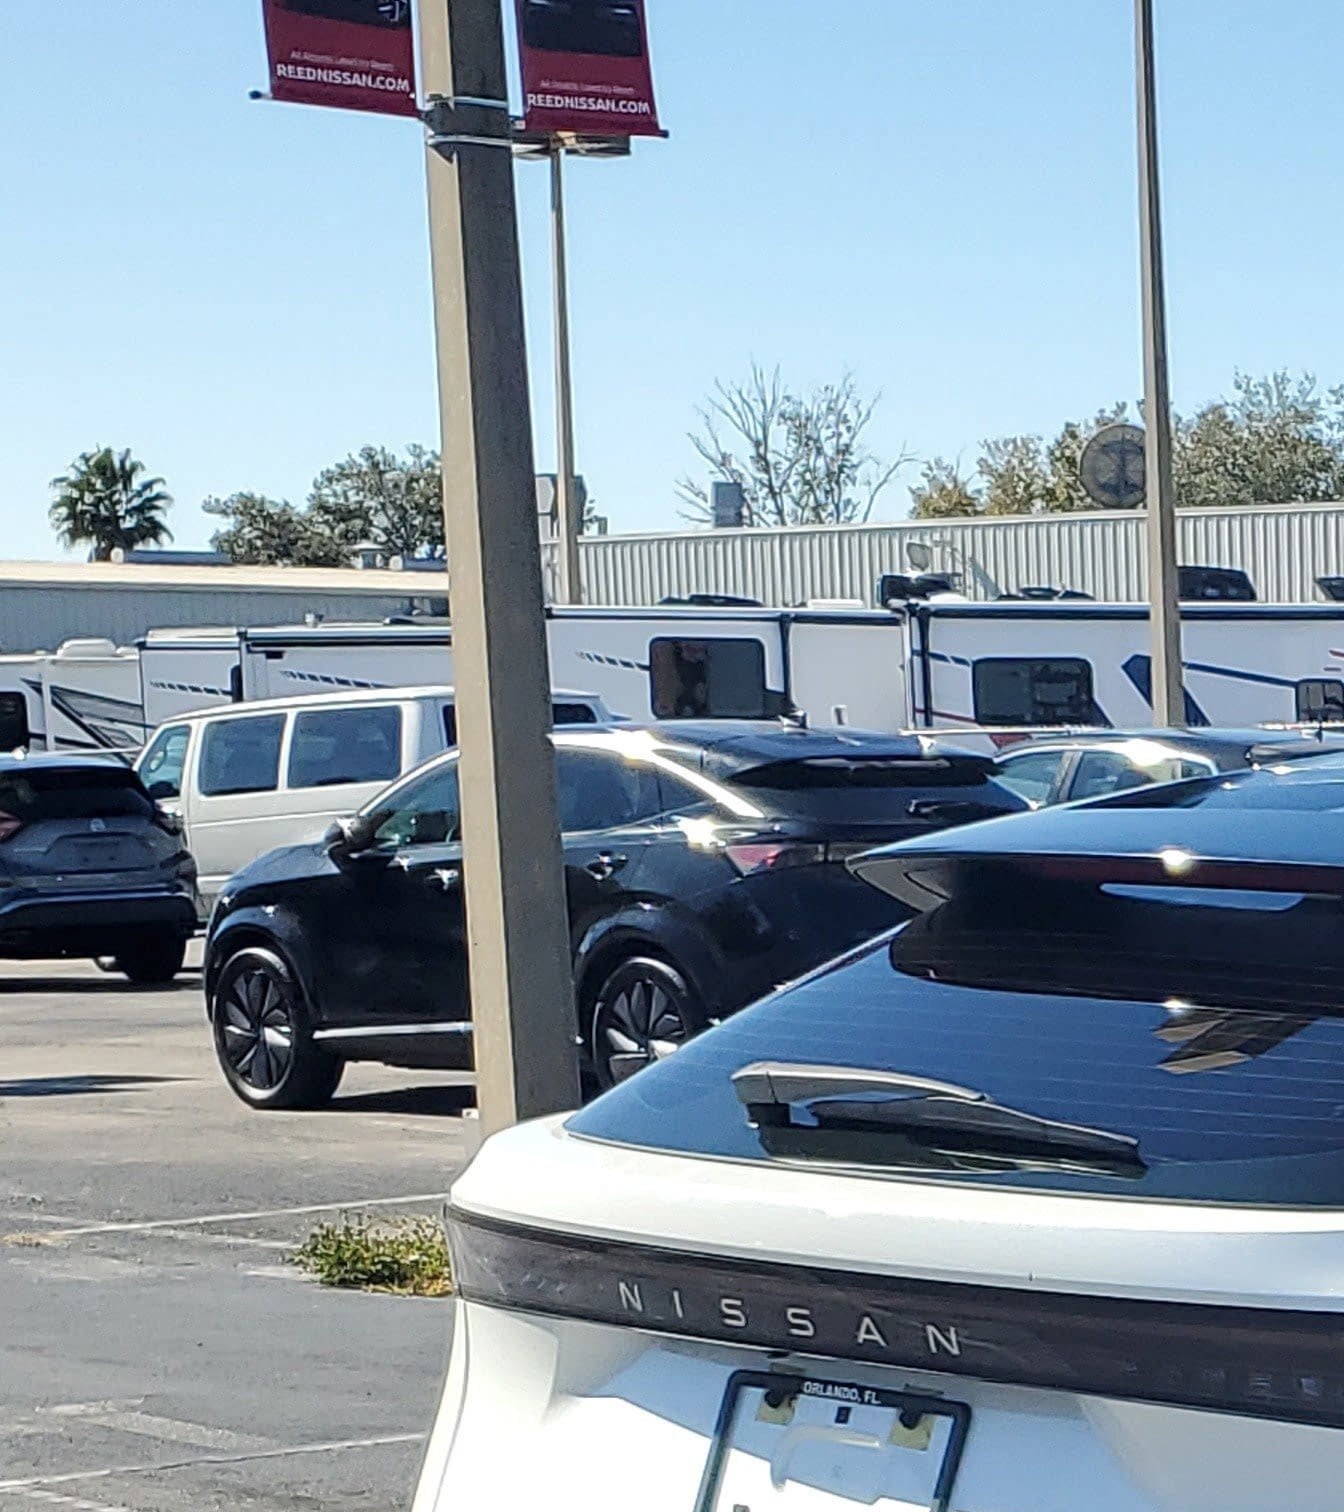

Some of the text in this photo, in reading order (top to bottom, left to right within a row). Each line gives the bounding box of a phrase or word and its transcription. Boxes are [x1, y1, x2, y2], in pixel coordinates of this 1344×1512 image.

[276, 63, 410, 92] REEDNISSAN.COM
[526, 93, 650, 114] REEDNISSAN.COM
[618, 1281, 961, 1356] NISSAN
[803, 1381, 881, 1404] ORLANDO, FL
